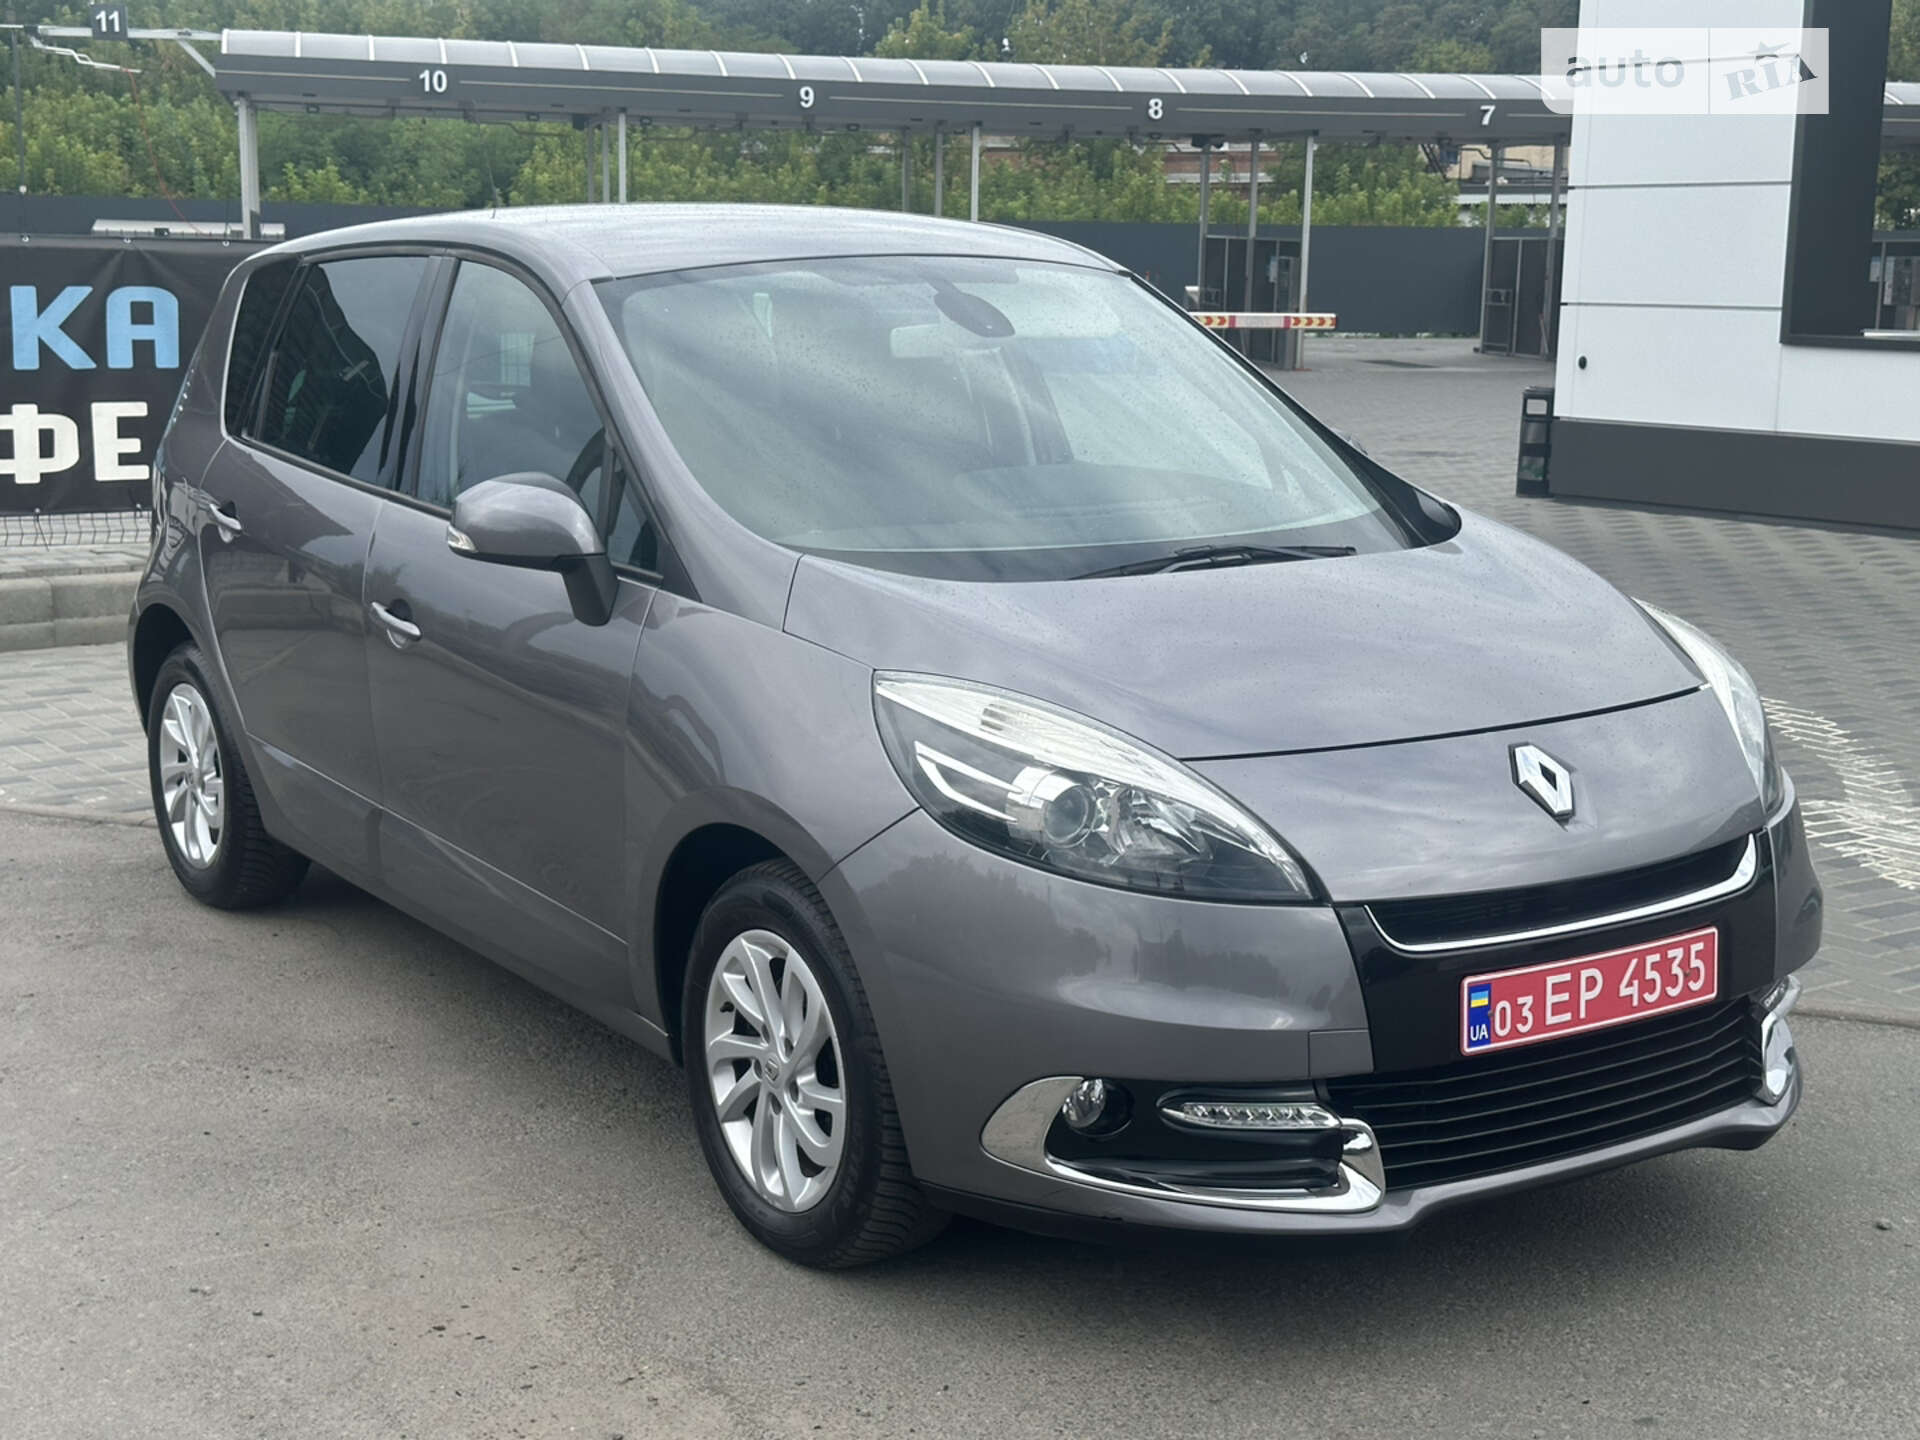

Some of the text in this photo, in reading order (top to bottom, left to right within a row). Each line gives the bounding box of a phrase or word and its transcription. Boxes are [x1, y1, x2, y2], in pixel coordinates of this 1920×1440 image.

[95, 10, 120, 32] 11
[419, 69, 448, 93] 10
[799, 86, 815, 108] 9
[1148, 98, 1164, 119] 8
[1480, 104, 1496, 125] 7
[10, 284, 180, 370] КА
[0, 401, 150, 484] ФЕ
[1494, 942, 1706, 1037] 03 EP 4535
[1470, 1023, 1489, 1041] UA
